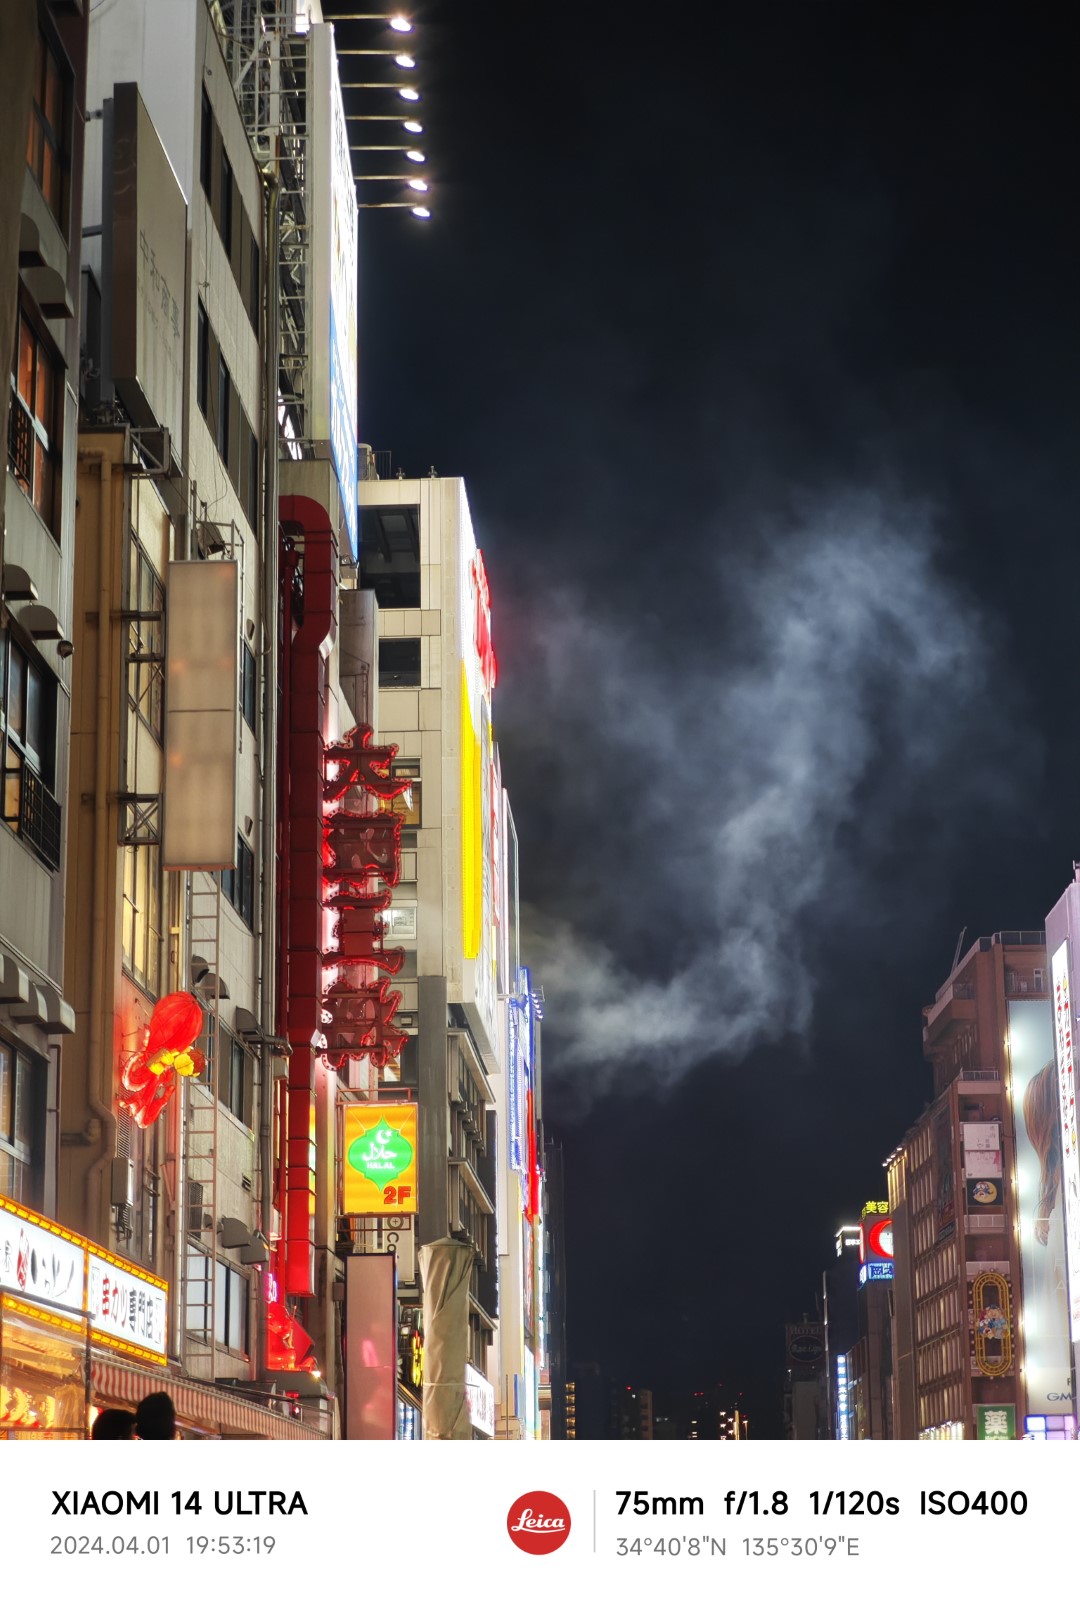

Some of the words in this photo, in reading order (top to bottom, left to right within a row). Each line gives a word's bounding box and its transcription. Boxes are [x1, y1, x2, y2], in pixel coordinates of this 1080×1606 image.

[362, 1142, 398, 1161] حلال
[367, 1161, 395, 1169] HALAL
[383, 1186, 411, 1205] 2F
[865, 1201, 889, 1214] 美容
